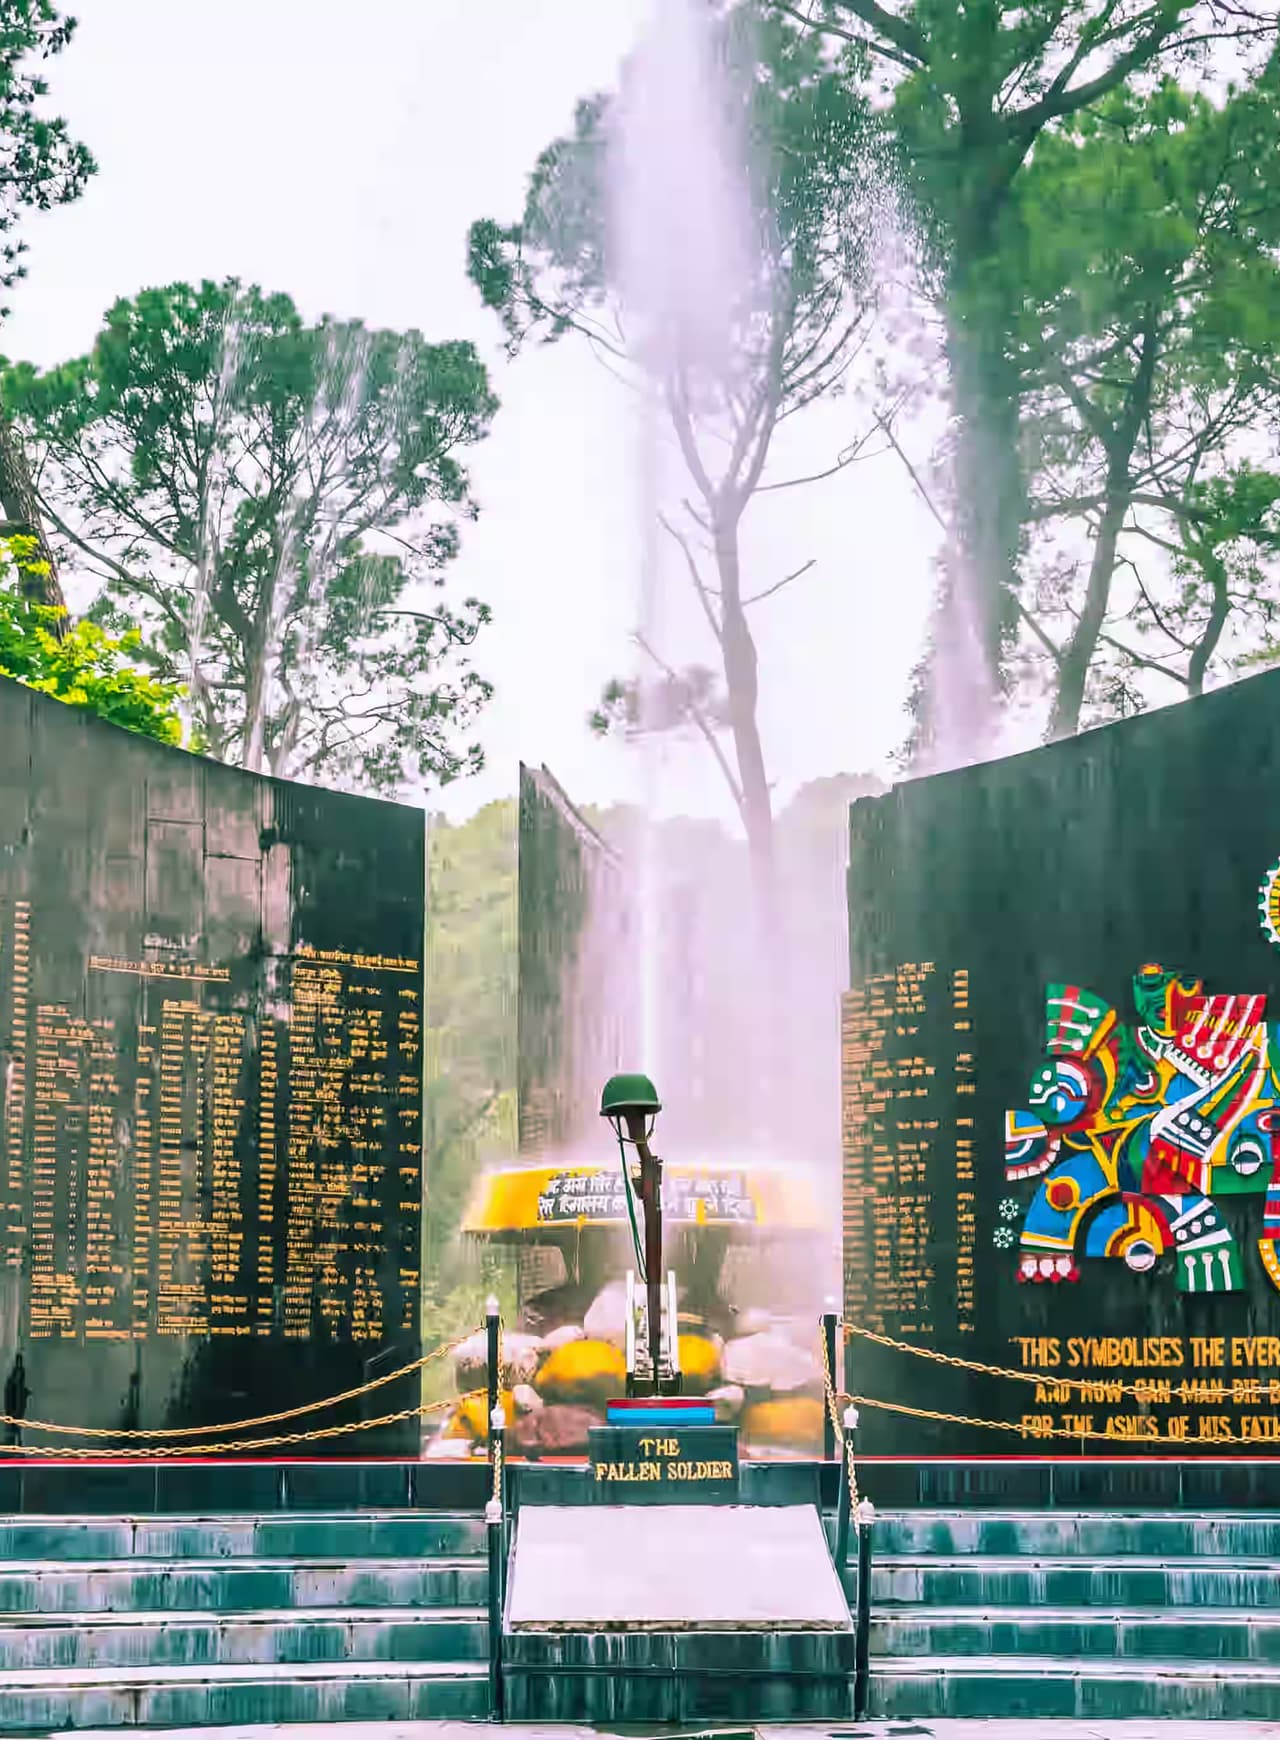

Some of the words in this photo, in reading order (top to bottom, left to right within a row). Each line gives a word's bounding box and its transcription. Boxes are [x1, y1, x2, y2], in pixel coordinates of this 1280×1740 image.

[1067, 1336, 1184, 1367] SYMBOLISES
[1189, 1336, 1225, 1367] THE
[1231, 1335, 1280, 1367] EVER
[1021, 1415, 1053, 1439] FOR
[1061, 1415, 1093, 1439] THE
[1168, 1415, 1189, 1440] OF
[1199, 1415, 1232, 1440] HIS
[639, 1438, 680, 1457] THE
[595, 1462, 661, 1481] FALLEN
[667, 1461, 733, 1481] SOLDIER
